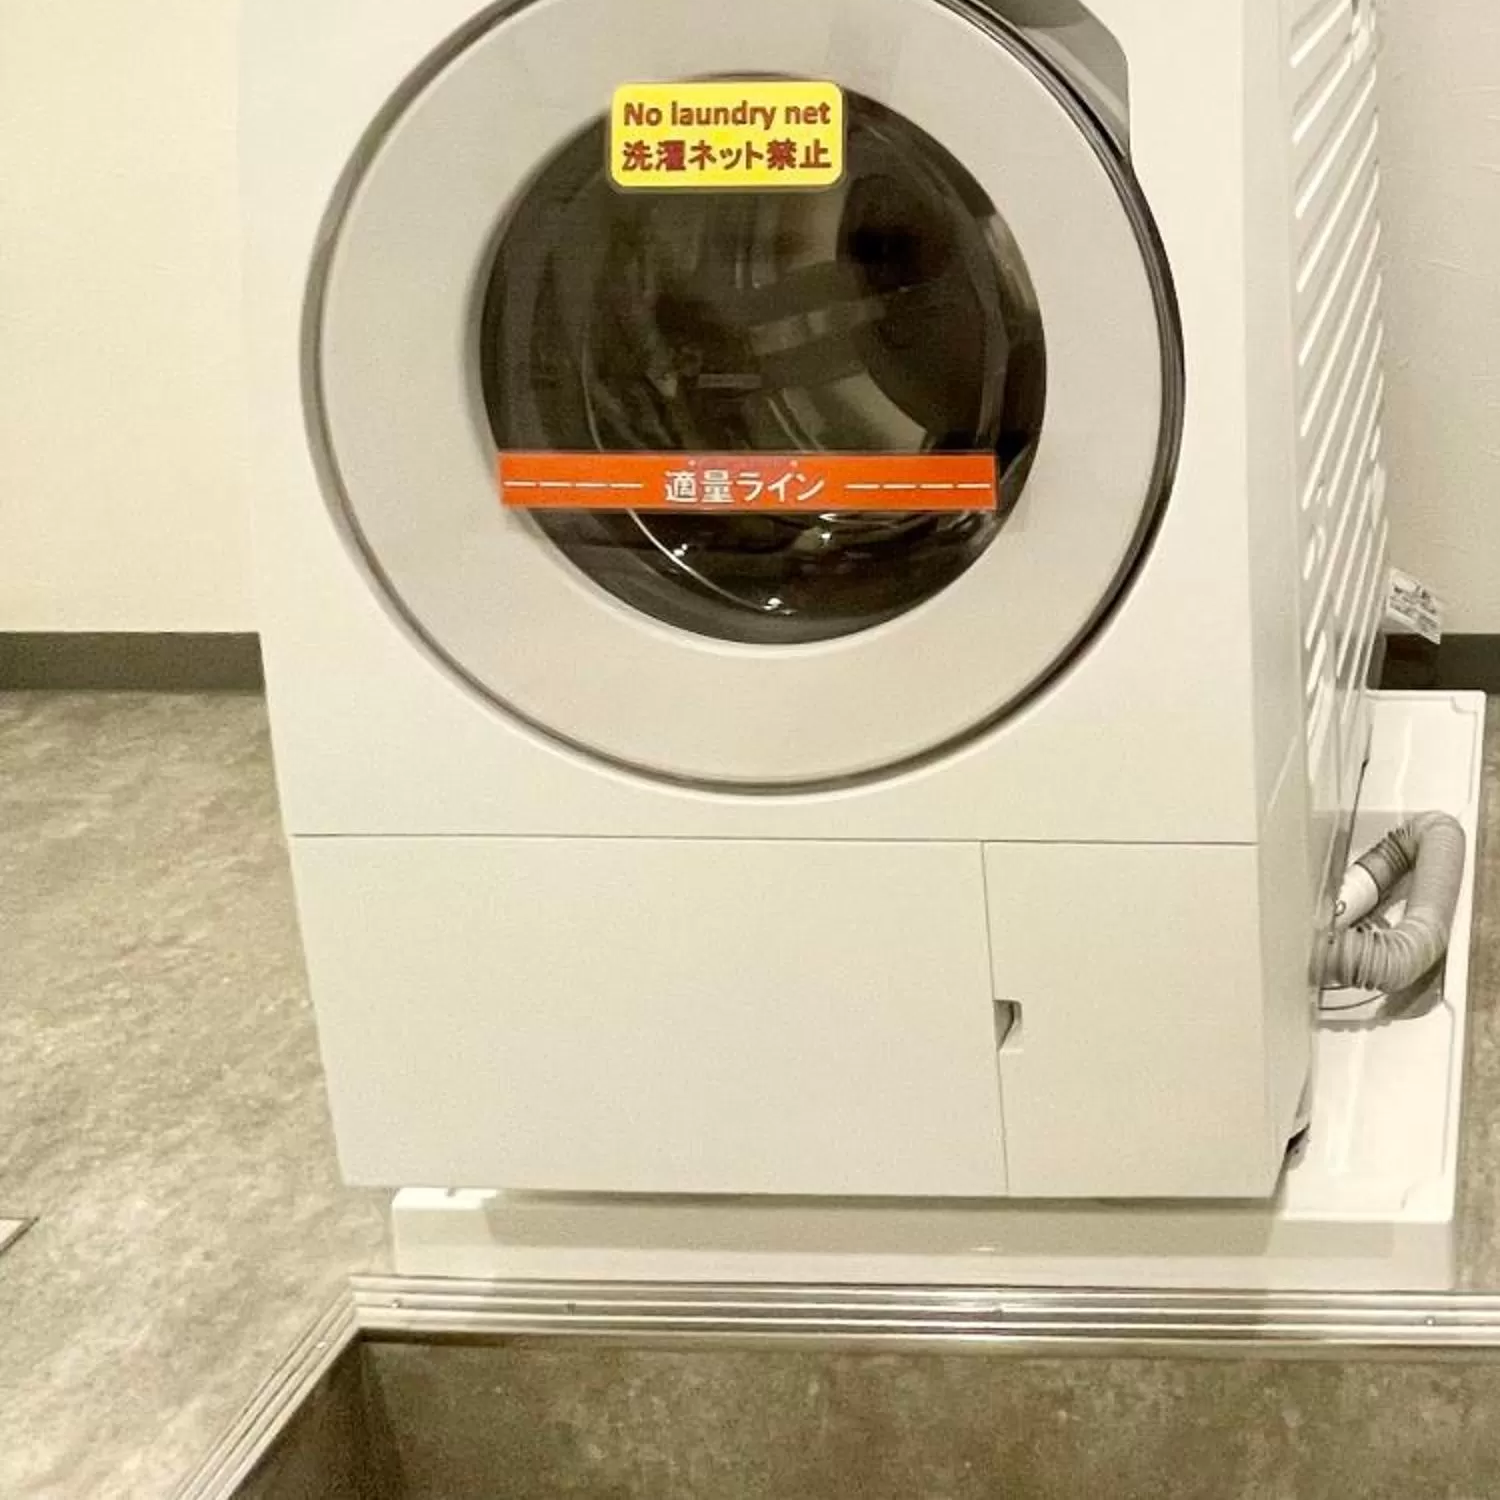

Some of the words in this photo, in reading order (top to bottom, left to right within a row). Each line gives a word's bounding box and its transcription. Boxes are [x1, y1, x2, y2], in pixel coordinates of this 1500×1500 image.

[623, 102, 662, 126] No
[671, 100, 776, 130] laundry
[784, 102, 831, 125] net
[621, 139, 832, 171] 洗濯ネット禁止
[664, 470, 825, 504] 適量ライン
